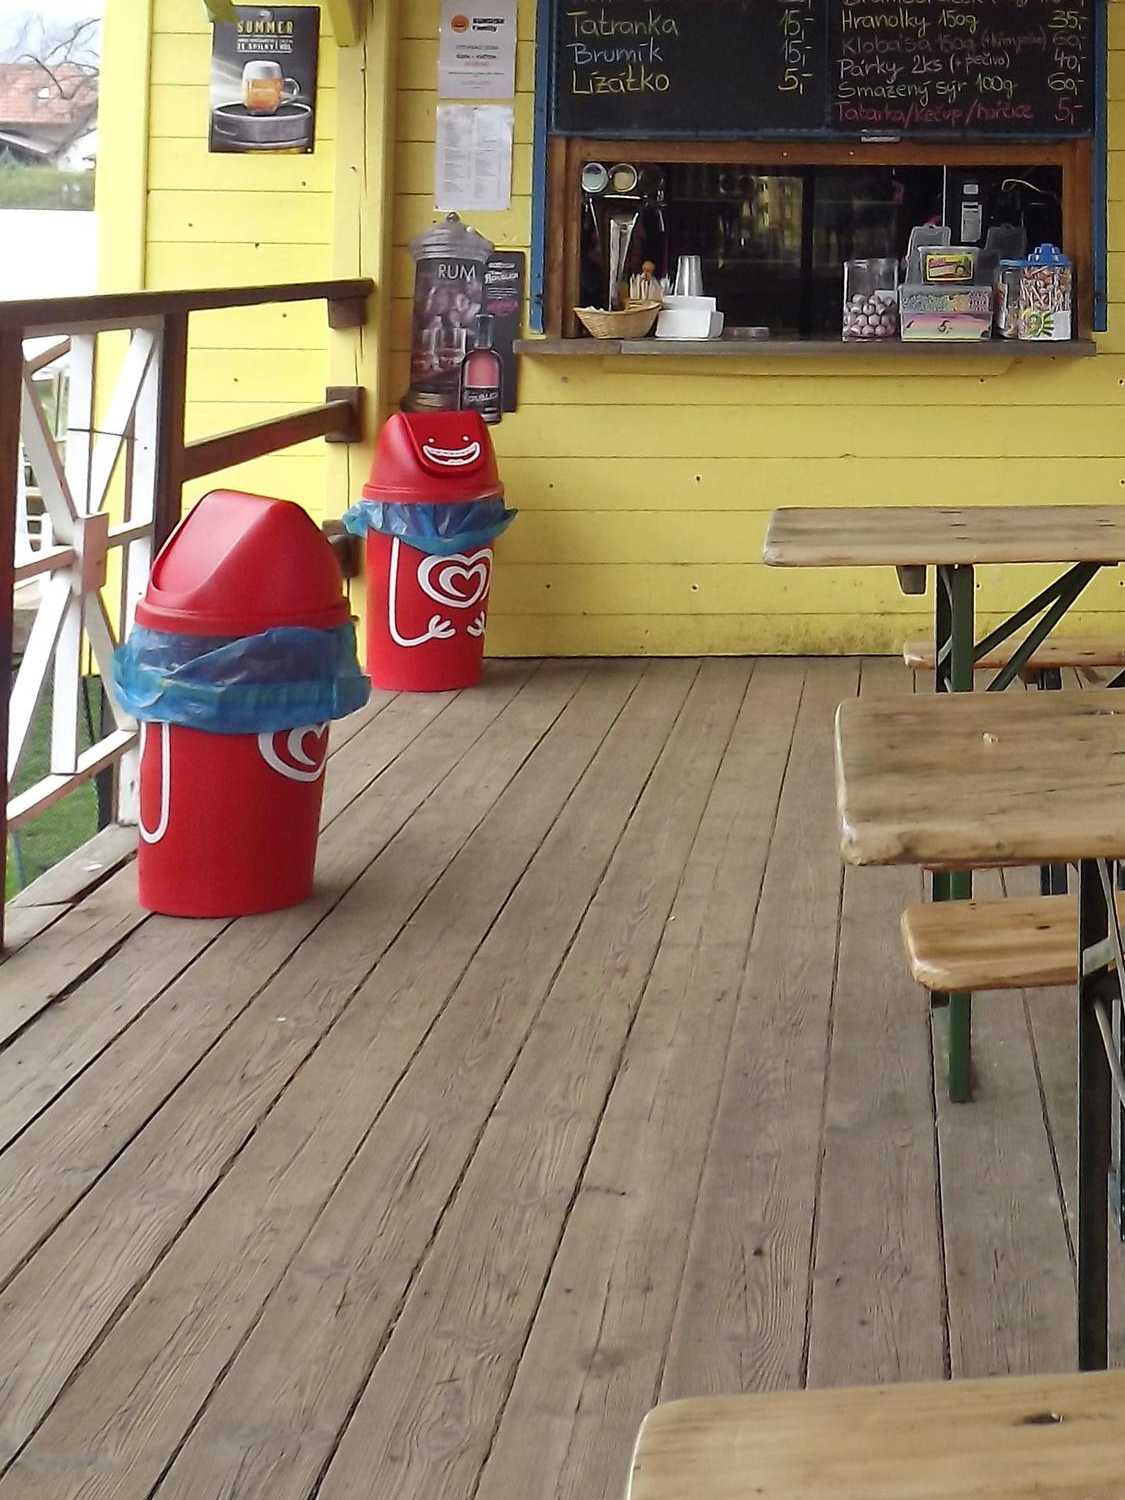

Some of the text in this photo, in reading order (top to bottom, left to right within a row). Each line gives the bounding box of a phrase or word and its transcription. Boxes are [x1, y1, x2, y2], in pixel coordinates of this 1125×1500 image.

[236, 20, 294, 34] SUMMER
[567, 8, 680, 38] Tatranka
[841, 6, 930, 38] Hranolky
[938, 9, 978, 34] 150g
[567, 36, 664, 65] Brumík
[836, 58, 903, 84] Párky
[911, 54, 944, 74] 2ks
[837, 80, 930, 106] Smažený
[935, 79, 968, 101] sýr
[437, 263, 477, 280] RUM
